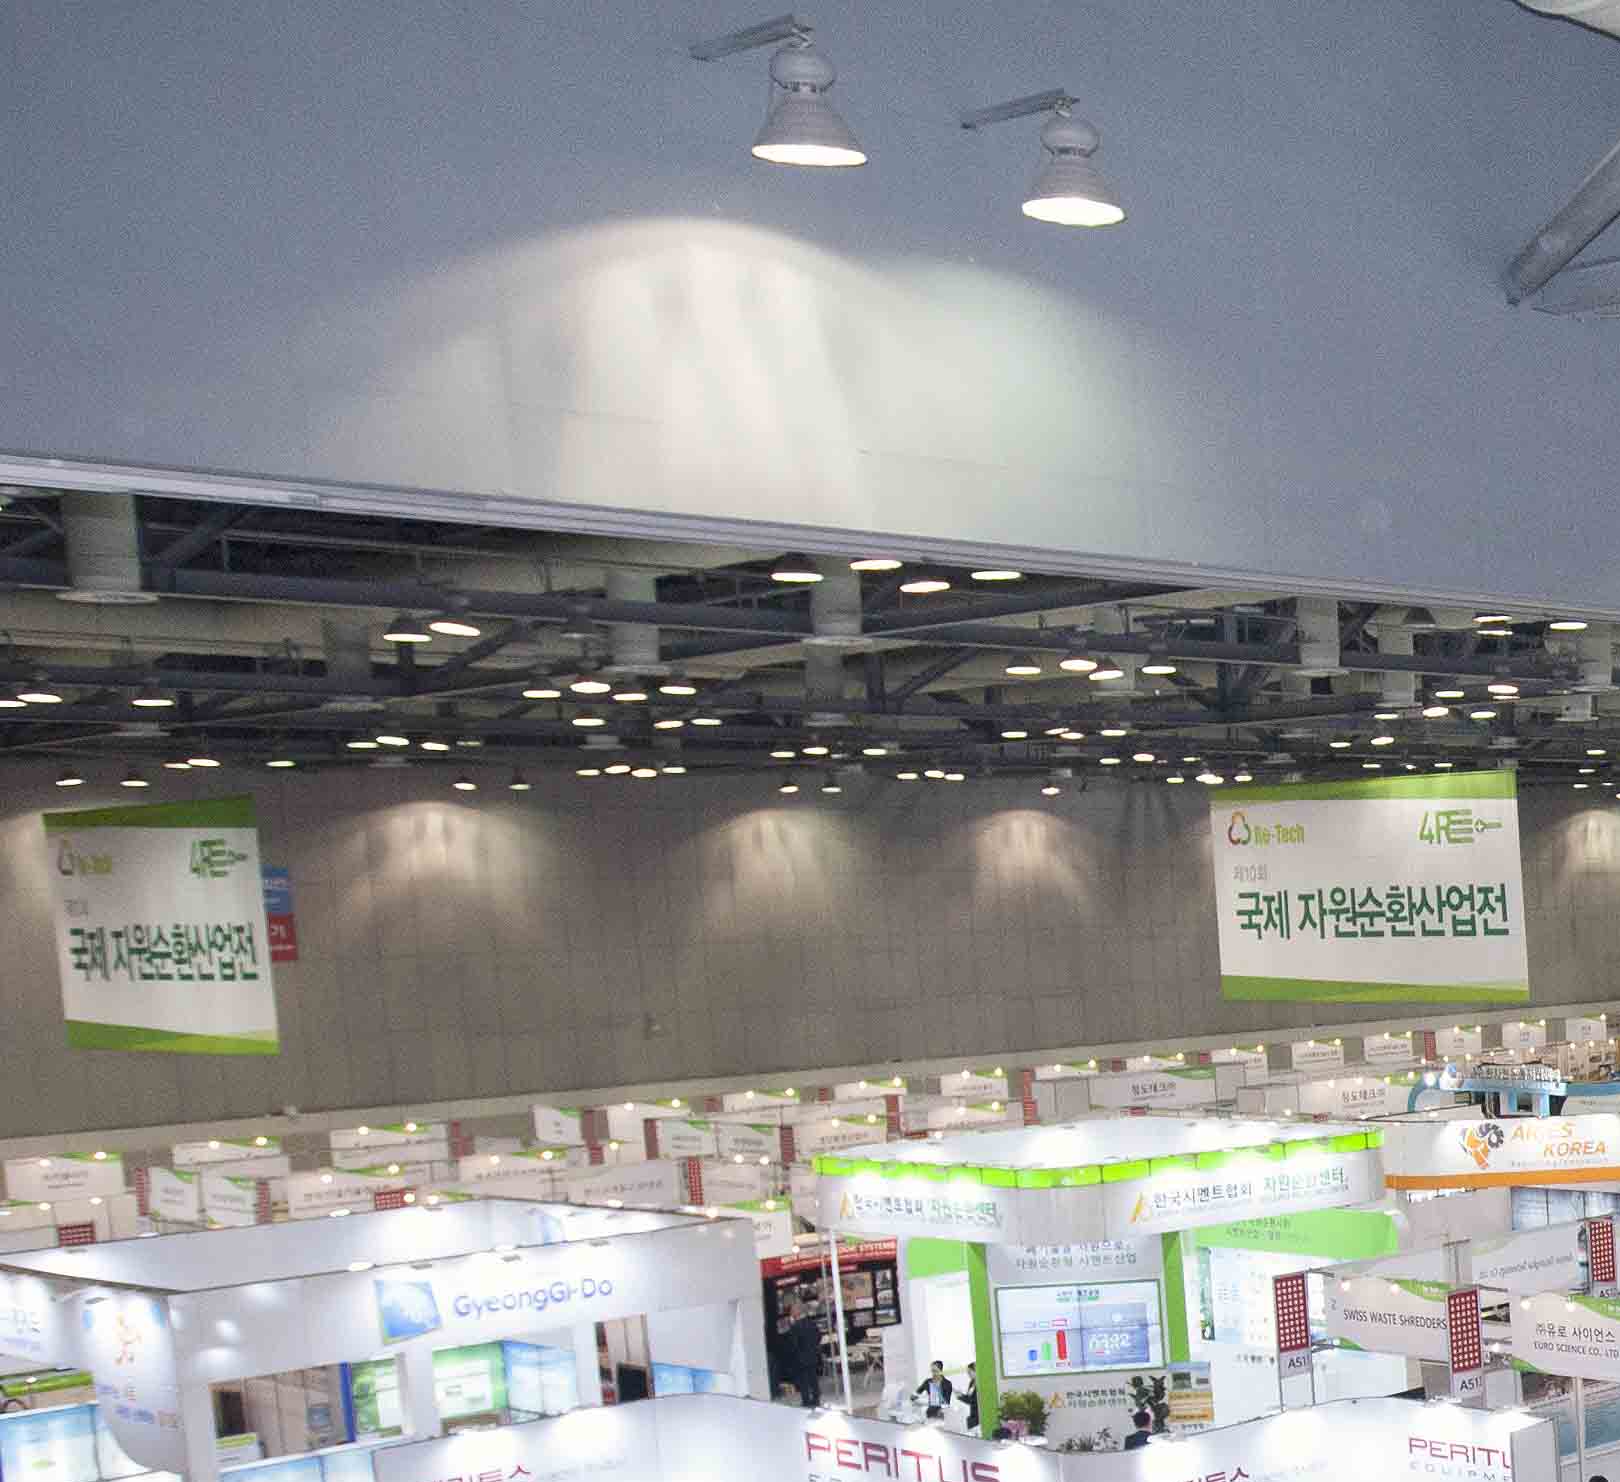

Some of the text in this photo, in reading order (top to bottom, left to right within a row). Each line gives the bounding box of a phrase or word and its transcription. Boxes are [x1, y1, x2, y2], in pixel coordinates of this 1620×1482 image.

[1236, 883, 1510, 940] 국제 자원순환산업전
[69, 921, 259, 981] 국제 자원순환산업전
[1543, 1141, 1606, 1158] KOREA
[1153, 1183, 1253, 1210] 한국시멘트협회
[1343, 1308, 1448, 1330] SWISS WASTE SHREDDERS
[1535, 1322, 1616, 1343] (주)유로 사이언스
[1534, 1340, 1556, 1352] EURO
[1557, 1342, 1587, 1356] SCIENCE
[1605, 1346, 1619, 1359] LTD
[1408, 1436, 1513, 1468] PERITU
